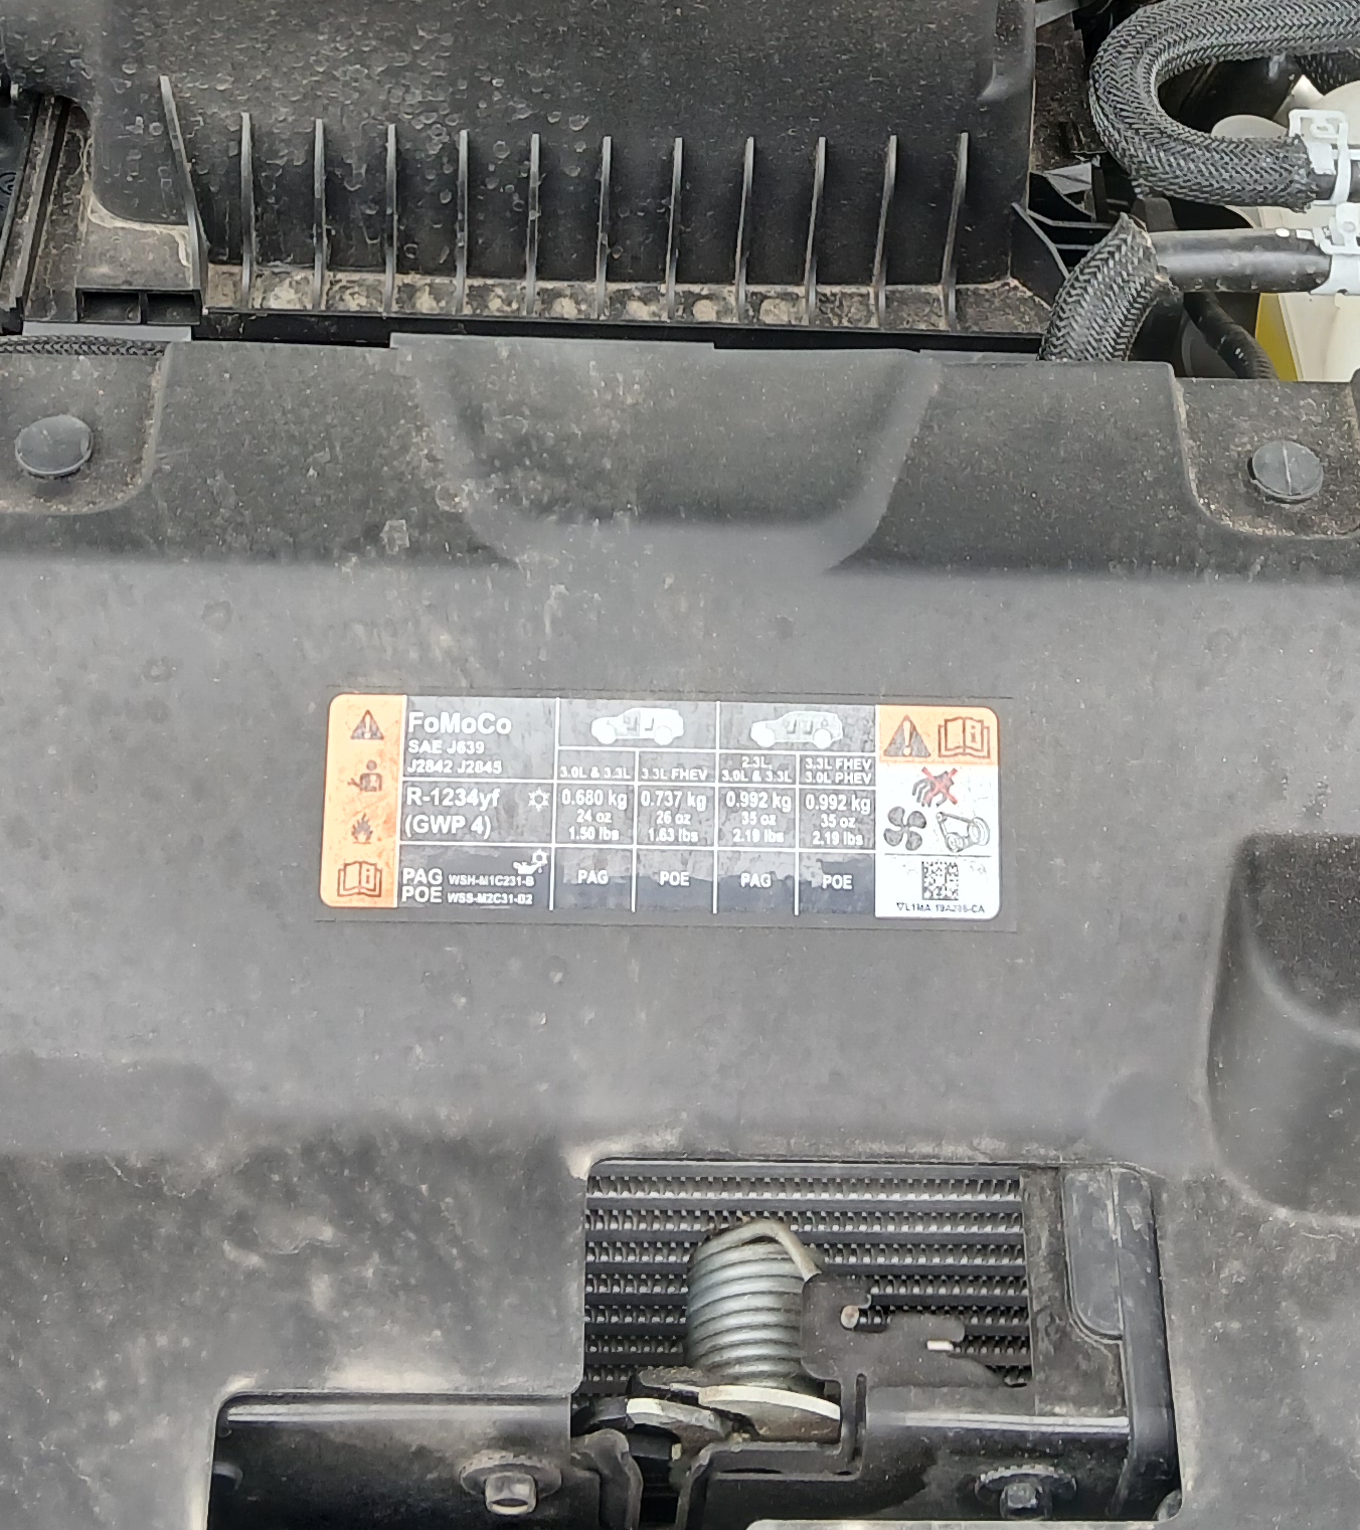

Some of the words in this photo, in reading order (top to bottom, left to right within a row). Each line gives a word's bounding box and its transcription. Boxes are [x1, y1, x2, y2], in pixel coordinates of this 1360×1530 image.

[408, 712, 512, 735] FoMoCo
[408, 739, 443, 753] SAE
[446, 740, 485, 755] J639
[407, 759, 453, 773] J2842
[805, 758, 832, 769] 3.3L
[835, 758, 872, 770] FHEV
[560, 766, 587, 778] 3.0L
[590, 766, 600, 778] &
[603, 767, 631, 779] 3.3L
[641, 768, 667, 779] 3.3L
[671, 768, 708, 780] FHEV
[722, 770, 748, 782] 3.0L
[752, 770, 762, 782] &
[765, 770, 792, 783] 3.3L
[805, 771, 832, 783] 3.0L
[835, 772, 872, 784] PHEV
[406, 787, 500, 810] R-1234yf
[561, 788, 604, 805] 0.680
[608, 789, 627, 810] kg
[641, 790, 683, 807] 0.737
[687, 791, 706, 811] kg
[725, 791, 768, 808] 0.992
[772, 792, 791, 812] kg
[805, 793, 847, 810] 0.992
[851, 794, 871, 815] kg
[576, 808, 593, 823] 24
[595, 812, 612, 823] oz
[656, 810, 672, 824] 26
[675, 813, 691, 825] oz
[742, 811, 757, 825] 35
[760, 814, 777, 826] oz
[821, 814, 836, 828] 35
[839, 816, 856, 828] oz
[405, 815, 465, 838] (GWP
[471, 816, 491, 839] 4)
[569, 826, 596, 840] 1.50
[599, 826, 620, 841] lbs
[648, 828, 675, 842] 1.63
[678, 828, 698, 842] lbs
[732, 828, 760, 843] 2.19
[764, 829, 784, 843] lbs
[812, 831, 840, 845] 2.19
[843, 831, 863, 845] lbs
[402, 867, 443, 885] PAG
[448, 874, 535, 886] WSH-M1C231-B
[577, 871, 609, 885] PAG
[659, 872, 690, 886] POE
[741, 873, 771, 888] PAG
[822, 874, 853, 890] POE
[401, 886, 443, 903] POE
